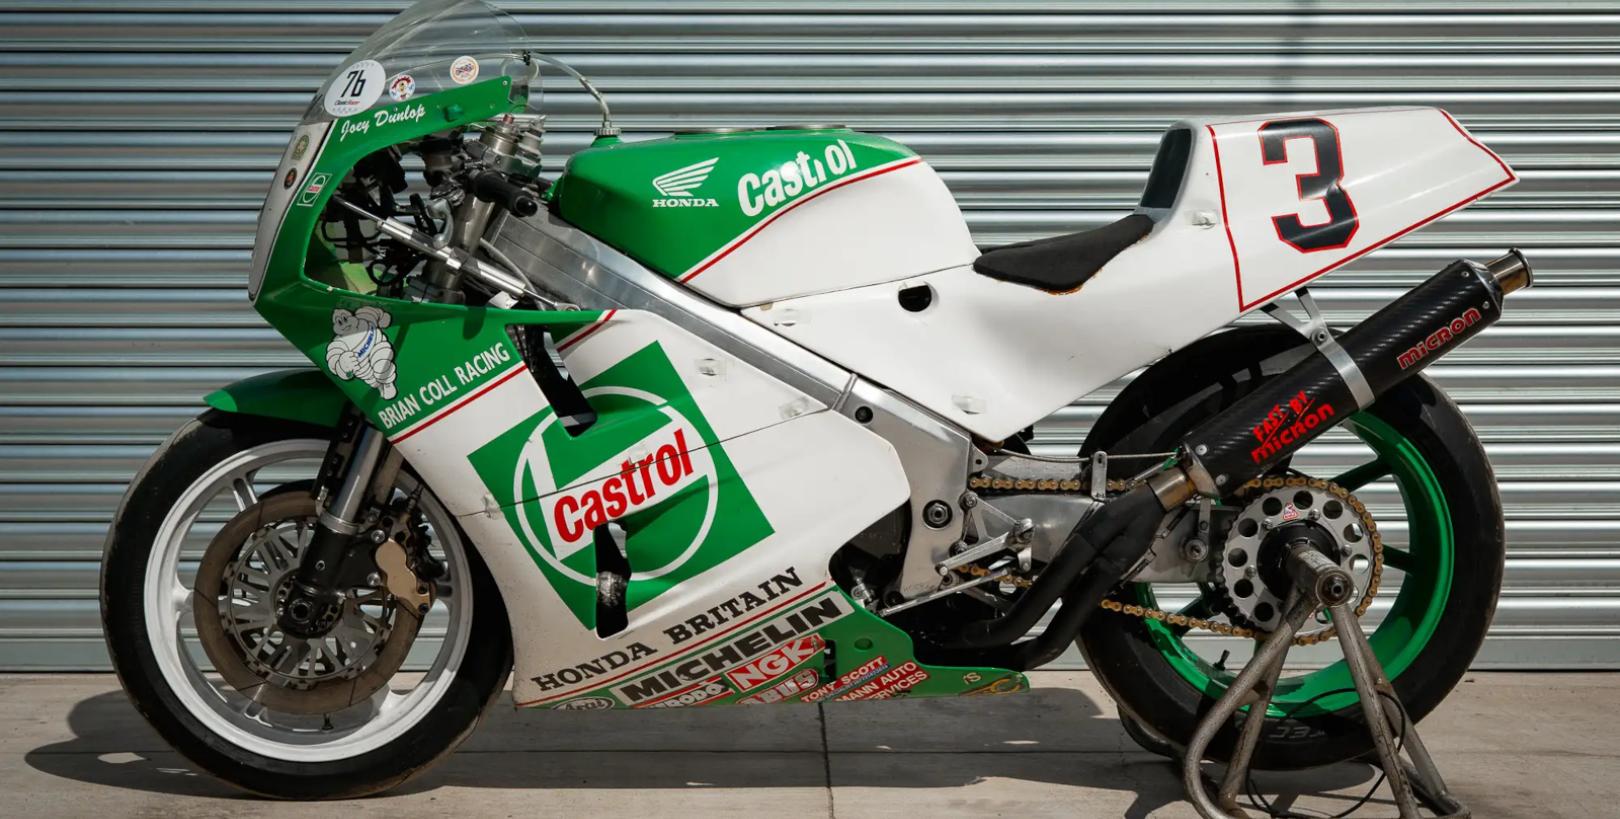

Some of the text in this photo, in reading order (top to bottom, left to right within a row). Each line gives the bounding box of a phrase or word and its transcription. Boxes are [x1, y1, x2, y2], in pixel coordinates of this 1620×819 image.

[340, 70, 366, 97] 76
[340, 103, 426, 142] Joey Dunlop
[652, 198, 719, 208] HONDA
[1257, 117, 1360, 254] 3
[378, 342, 511, 429] BRIAN COLL RACING
[1253, 390, 1312, 444] FAST BY
[554, 428, 694, 543] Castrol
[531, 566, 803, 691] HONDA BRITAIN
[619, 597, 843, 702] MICHELIN
[731, 639, 815, 690] NGK
[800, 681, 837, 702] TONY
[841, 656, 882, 685] SCOTT
[866, 671, 928, 700] RVICES
[880, 661, 917, 685] AUTO
[654, 683, 724, 707] RODO
